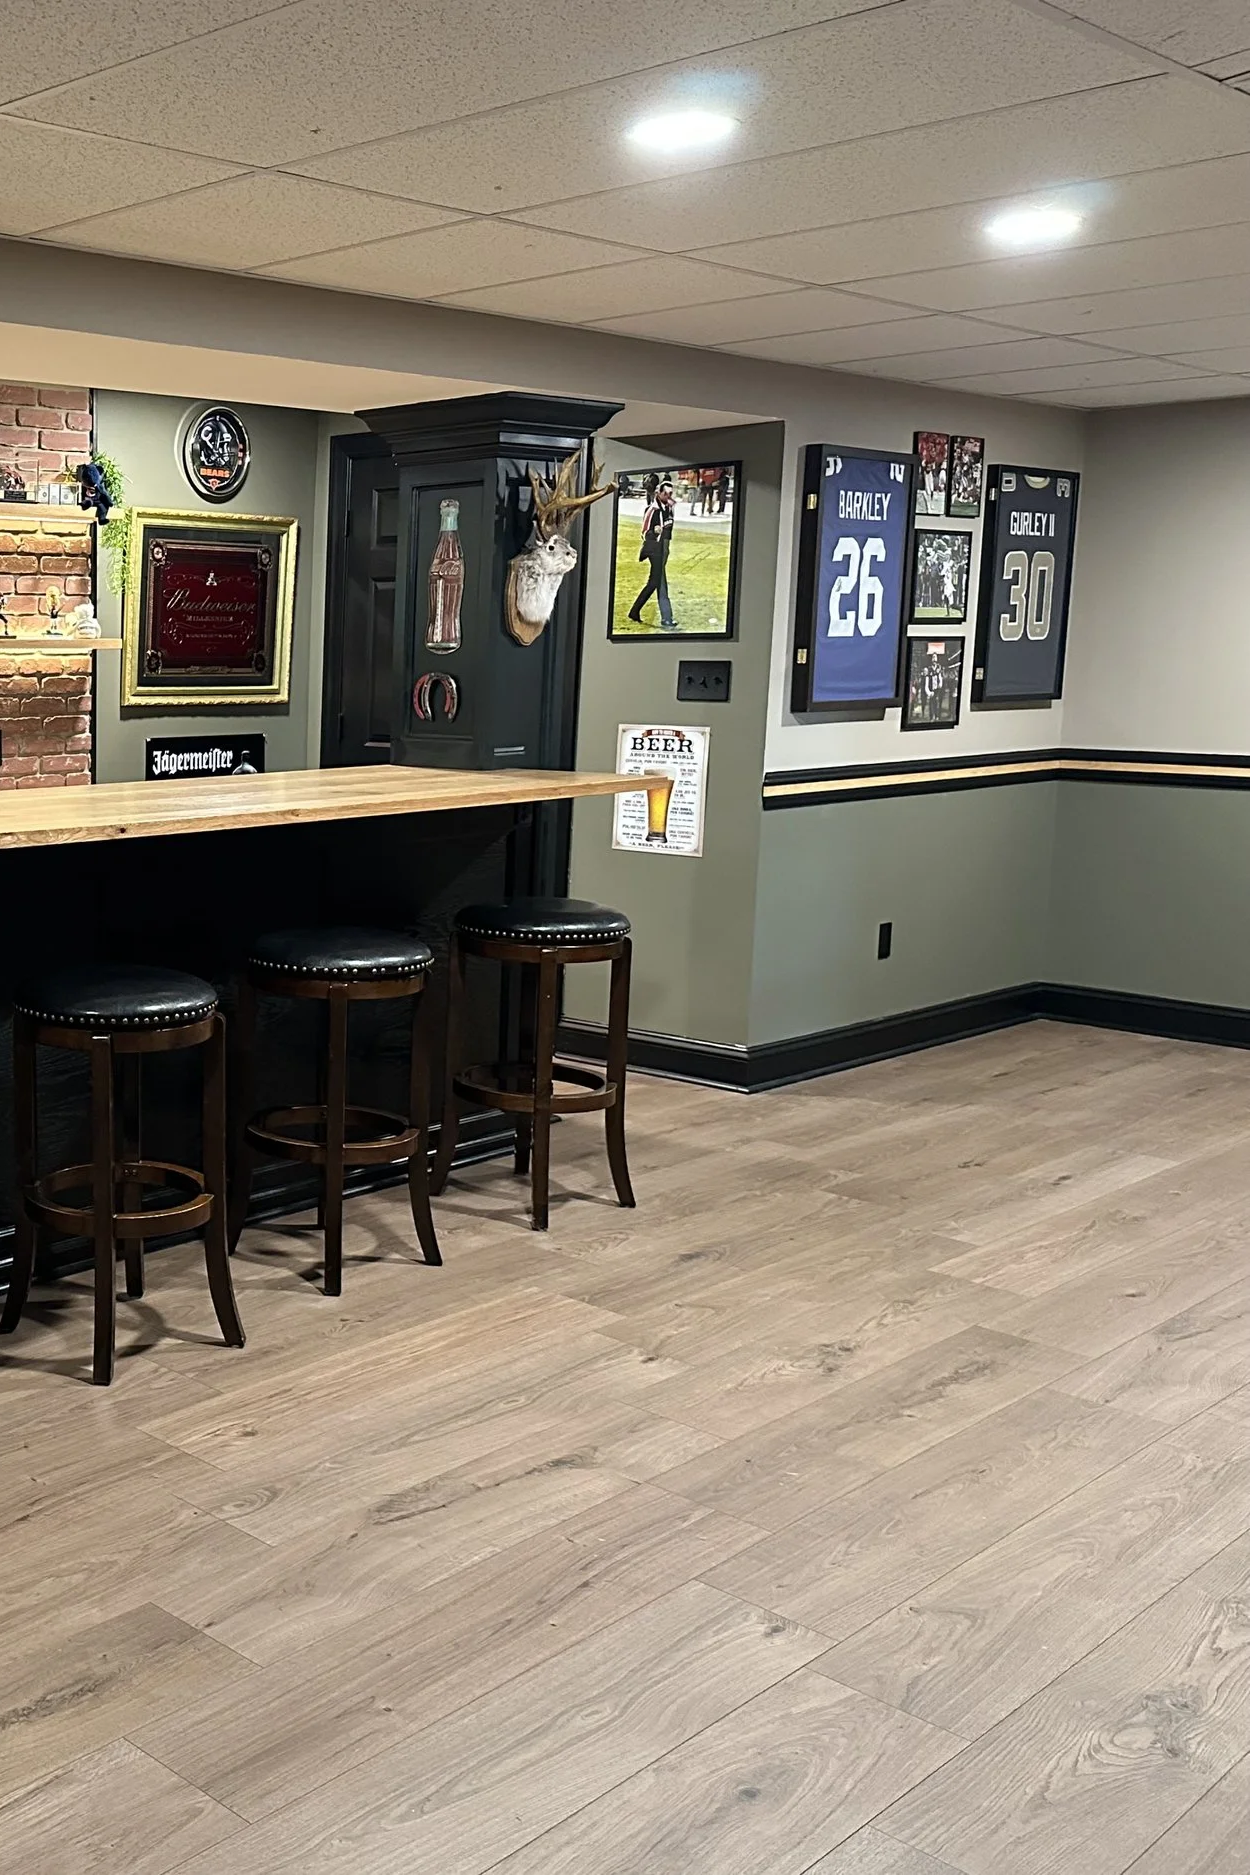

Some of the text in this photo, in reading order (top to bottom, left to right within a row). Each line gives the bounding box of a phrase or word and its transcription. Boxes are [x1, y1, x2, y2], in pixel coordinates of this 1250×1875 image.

[199, 467, 230, 478] BEARS
[838, 489, 891, 521] BARKLEY
[1010, 511, 1048, 537] GURLEY
[827, 537, 887, 637] 26
[1000, 550, 1055, 641] 30
[163, 588, 256, 613] Budweiser
[631, 737, 693, 752] BEER
[152, 748, 233, 775] Jägermeister
